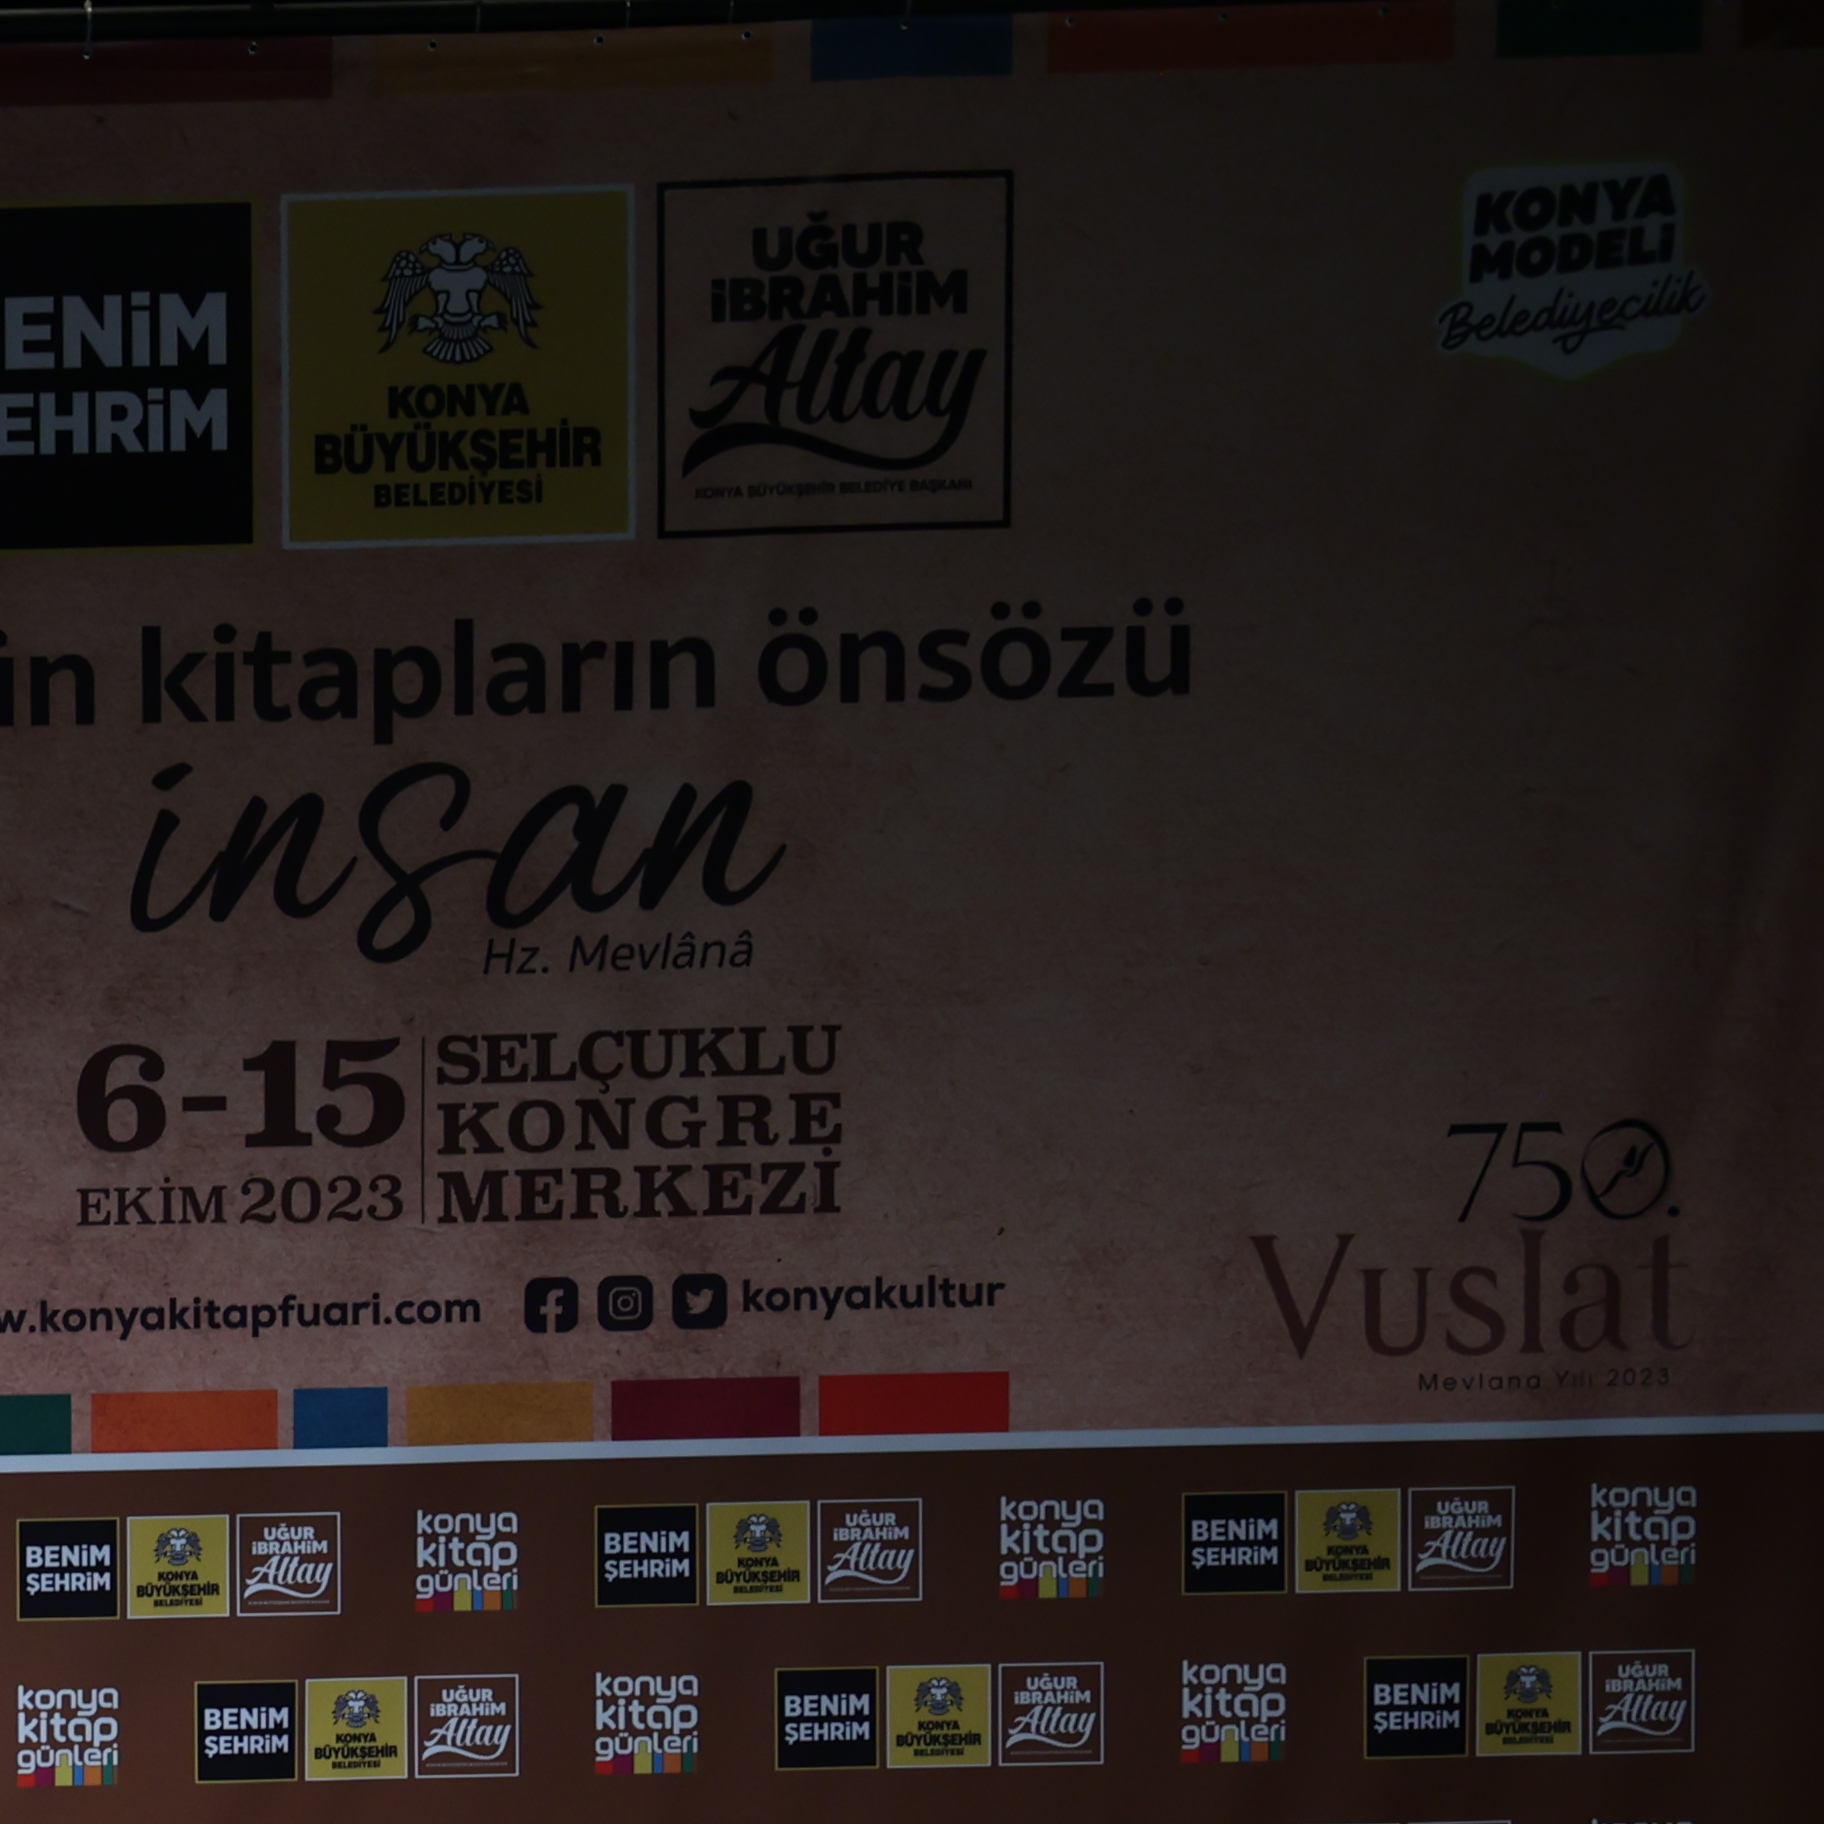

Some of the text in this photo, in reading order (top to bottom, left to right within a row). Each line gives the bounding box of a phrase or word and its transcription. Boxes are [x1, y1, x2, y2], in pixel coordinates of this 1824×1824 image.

[1474, 173, 1676, 236] KONYA
[752, 211, 925, 272] UĞUR
[1438, 270, 1706, 355] Belediyecilik
[388, 382, 529, 419] KONYA
[683, 324, 987, 478] Altay
[315, 418, 602, 476] BÜYÜKŞEHİR
[375, 473, 543, 507] BELEDİYESİ
[695, 487, 743, 499] KONYA
[748, 480, 835, 499] BÜYÜKŞEHİR
[839, 478, 904, 494] BELEDİYE
[140, 618, 718, 745] kitapların
[755, 597, 1191, 706] önsözü
[129, 760, 786, 964] insan
[483, 930, 753, 974] Hz. Mevlânâ
[436, 1024, 841, 1094] SELÇUKLU
[76, 1036, 406, 1153] 6-15
[436, 1091, 842, 1156] KONGRE
[76, 1174, 404, 1226] EKİM 2023
[437, 1147, 841, 1224] MERKEZİ
[740, 1273, 1005, 1318] konyakultur
[1249, 1229, 1695, 1360] Vuslat
[1418, 1373, 1541, 1391] Mevlana
[1607, 1367, 1671, 1387] 2023
[1591, 1482, 1697, 1515] konya
[416, 1508, 517, 1541] konya
[1590, 1508, 1697, 1548] kitap
[416, 1535, 517, 1573] kitap
[1590, 1541, 1697, 1573] günleri
[415, 1568, 518, 1599] günleri
[442, 1684, 494, 1702] UĞUR
[1182, 1659, 1287, 1692] konya
[17, 1684, 120, 1717] konya
[1181, 1685, 1287, 1724] kitap
[18, 1711, 118, 1748] kitap
[335, 1733, 377, 1744] KONYA
[422, 1716, 512, 1760] Altay
[1180, 1718, 1287, 1750] günleri
[17, 1743, 118, 1774] günleri
